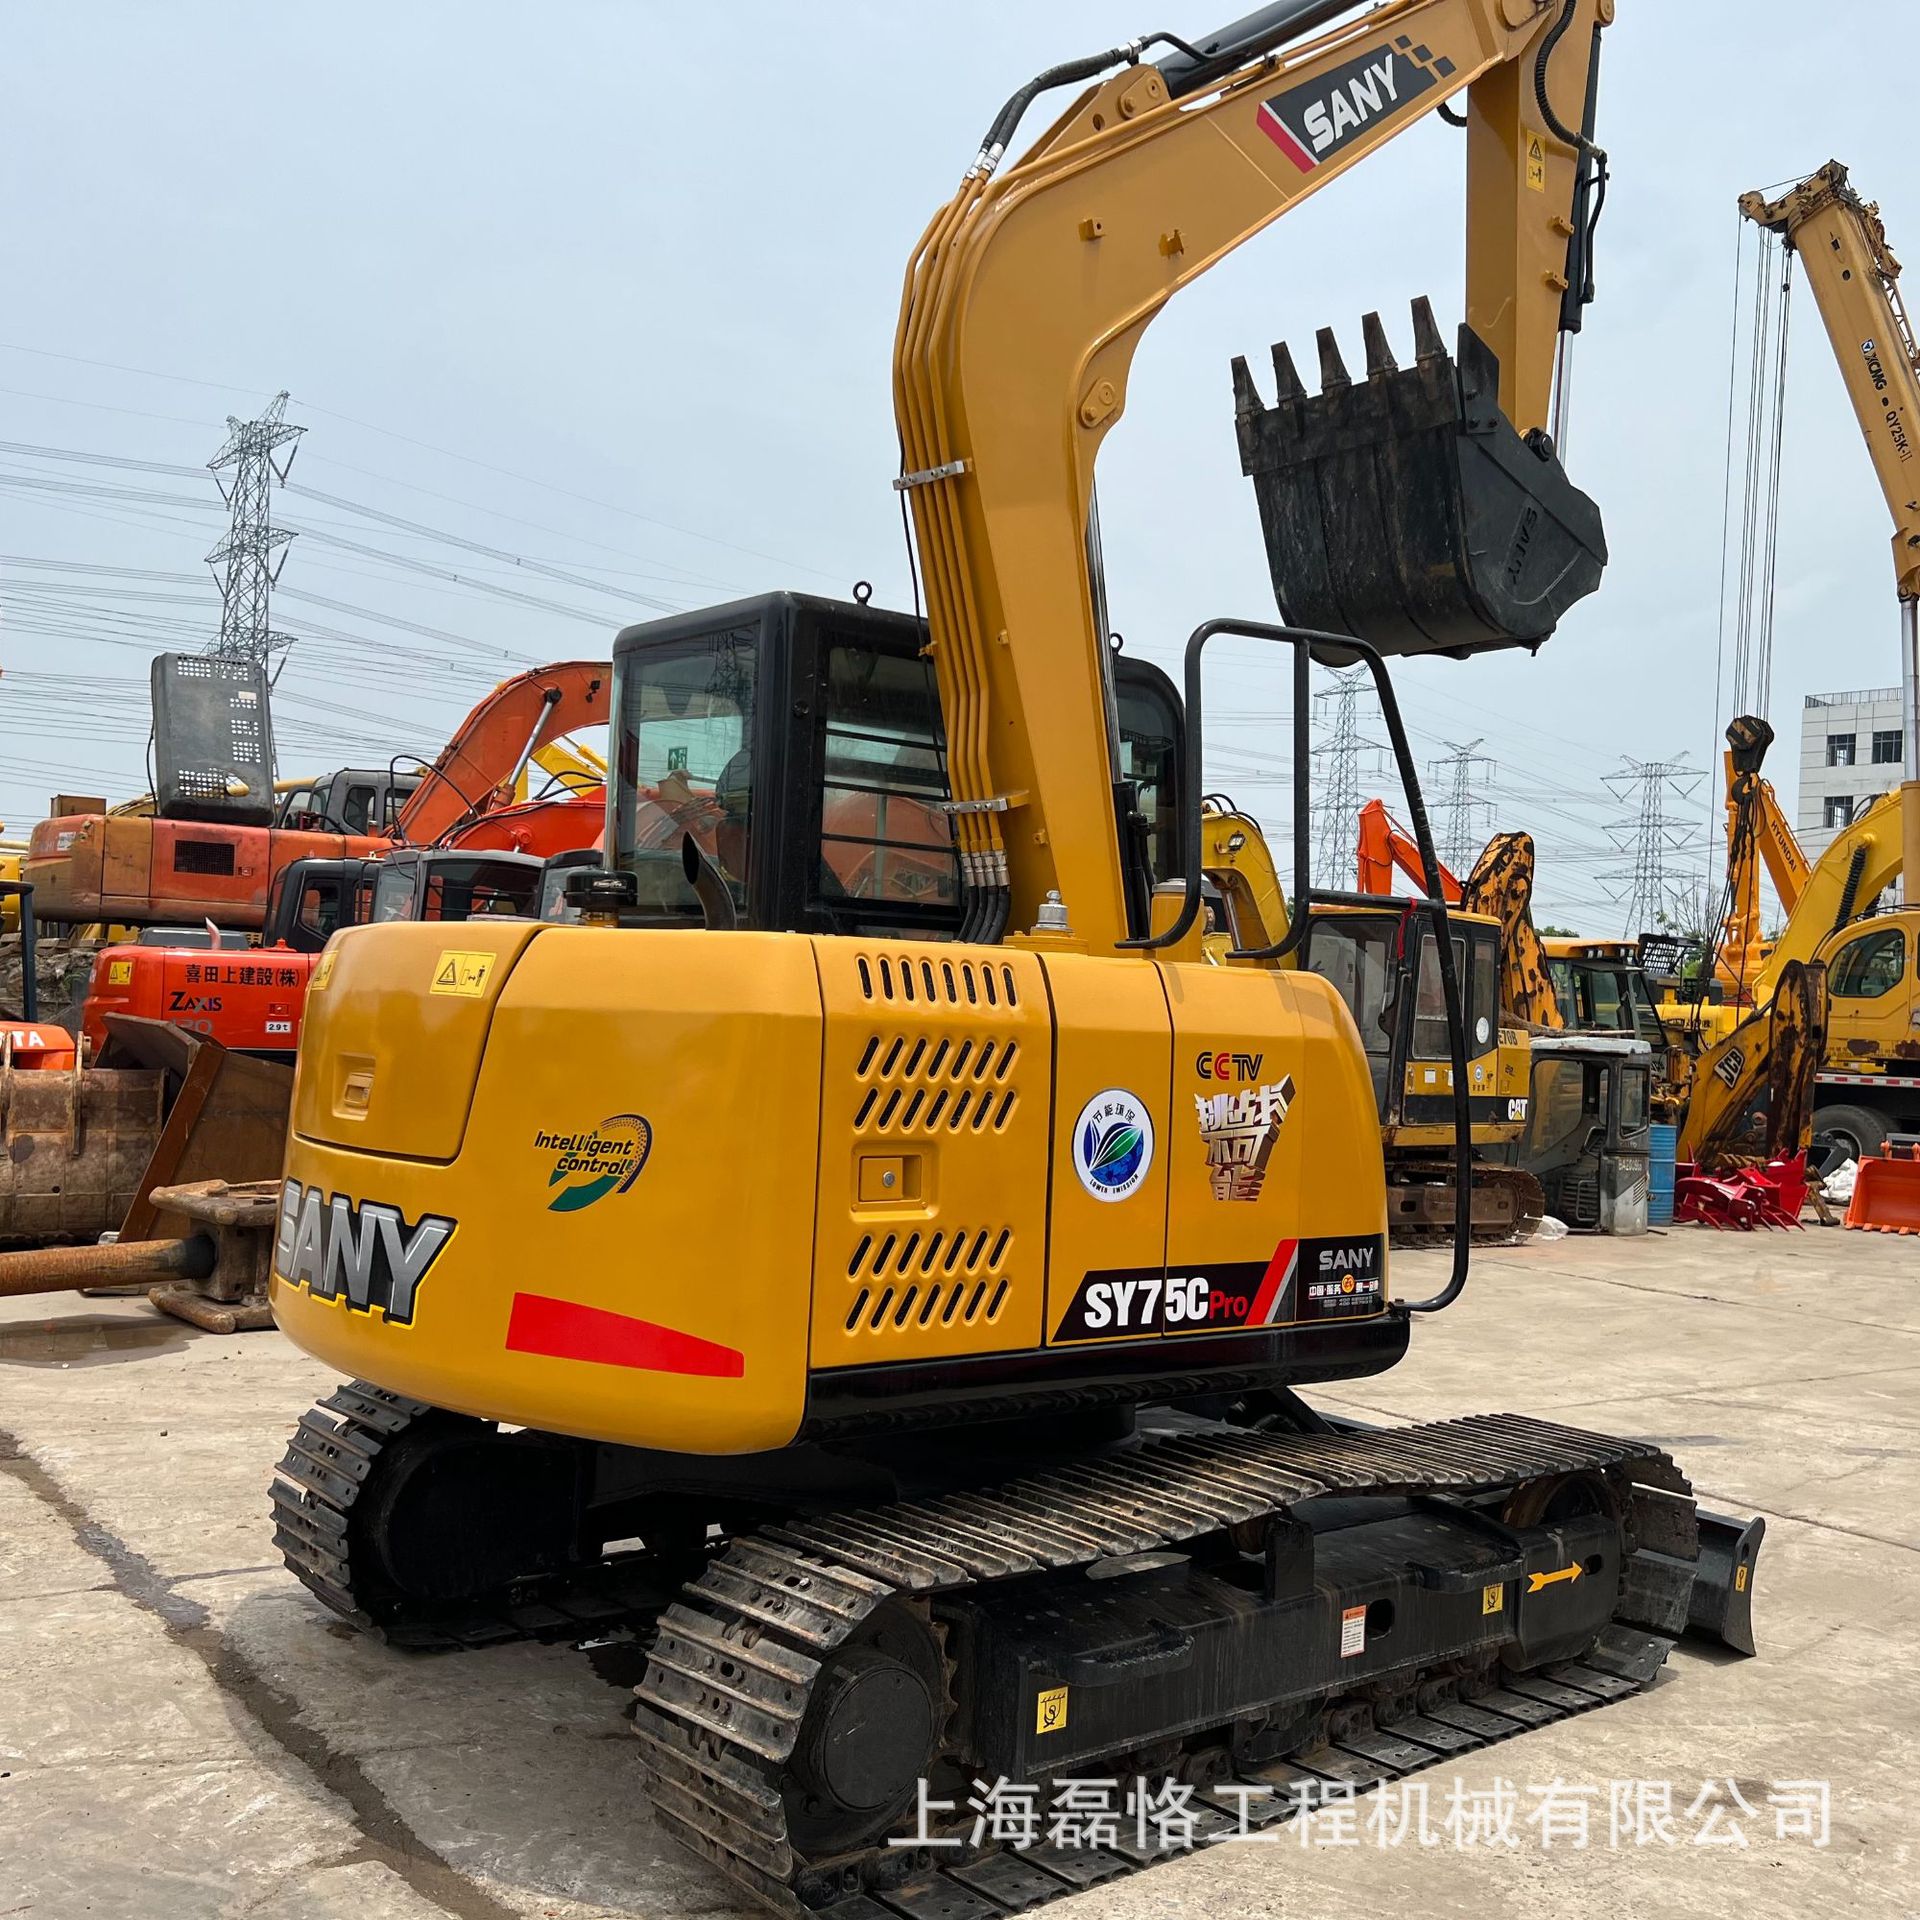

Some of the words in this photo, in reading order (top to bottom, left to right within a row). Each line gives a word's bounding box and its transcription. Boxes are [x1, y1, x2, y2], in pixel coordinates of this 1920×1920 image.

[1303, 53, 1398, 154] SANY
[1864, 353, 1888, 391] XCMG
[1771, 820, 1797, 872] HYUNDAI
[168, 991, 222, 1012] ZAXIS
[1196, 1051, 1264, 1082] CCTV
[1718, 1051, 1741, 1088] JCB
[1507, 1099, 1528, 1121] CAT
[534, 1130, 635, 1157] Intelligent
[556, 1157, 628, 1176] control
[276, 1174, 456, 1322] SANY
[1319, 1247, 1373, 1271] SANY
[1084, 1277, 1209, 1329] SY75C
[1209, 1290, 1249, 1320] Pro
